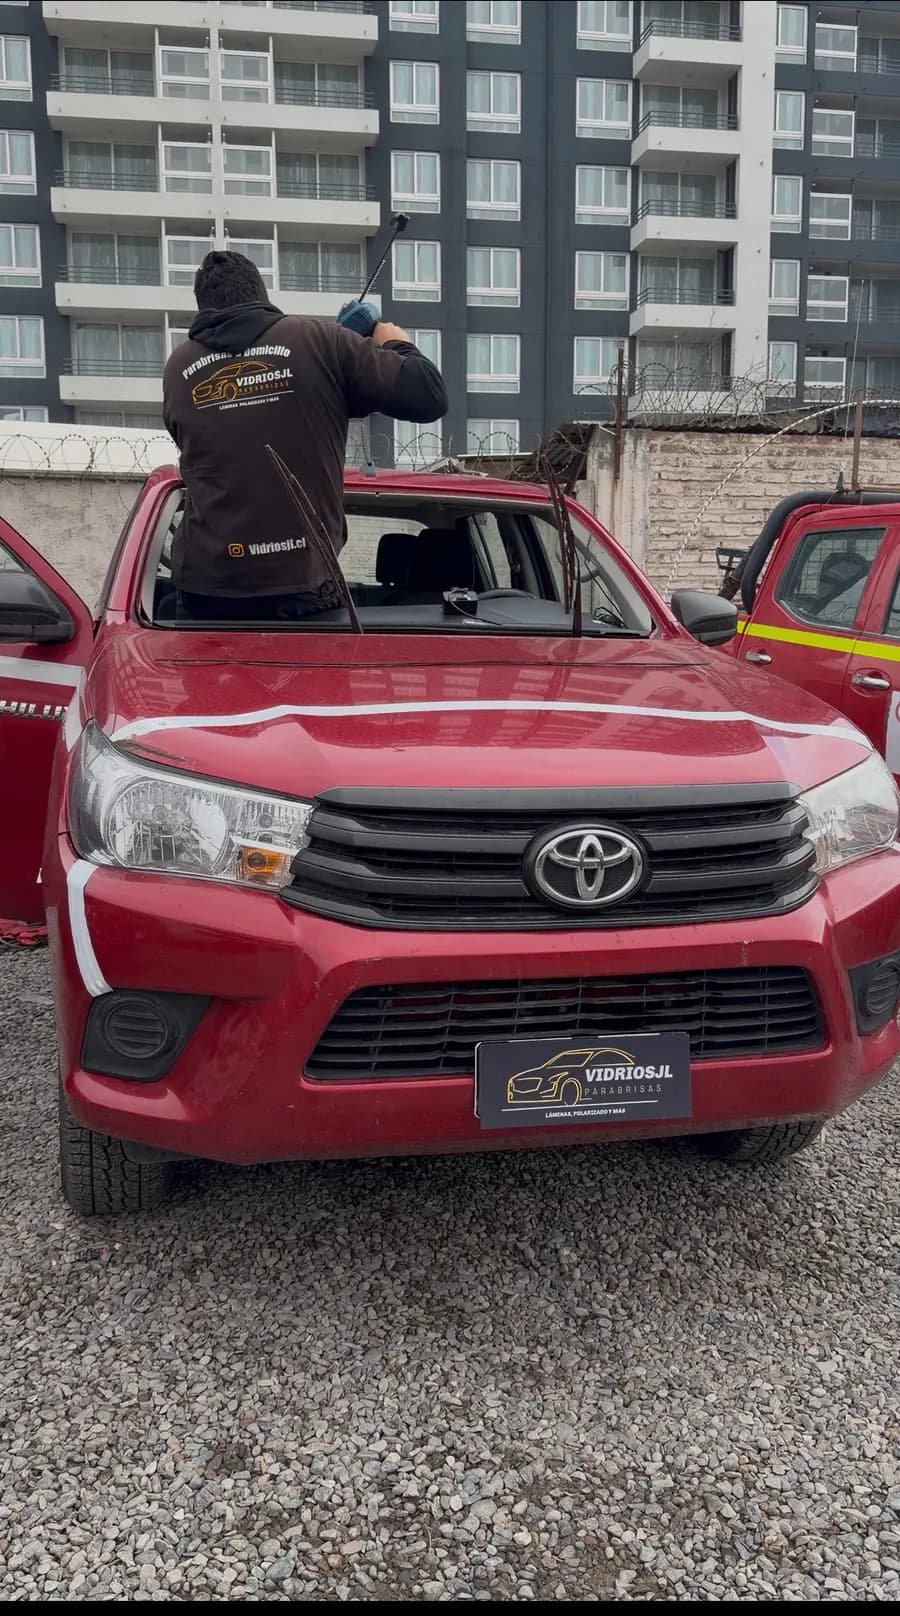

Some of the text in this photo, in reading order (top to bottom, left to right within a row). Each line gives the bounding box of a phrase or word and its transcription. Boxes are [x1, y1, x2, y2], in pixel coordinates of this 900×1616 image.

[243, 345, 291, 358] Domicilio
[236, 368, 293, 387] VIDRIOSJL
[585, 1065, 673, 1082] VIDRIOSJL
[585, 1084, 662, 1096] PARABRISAS
